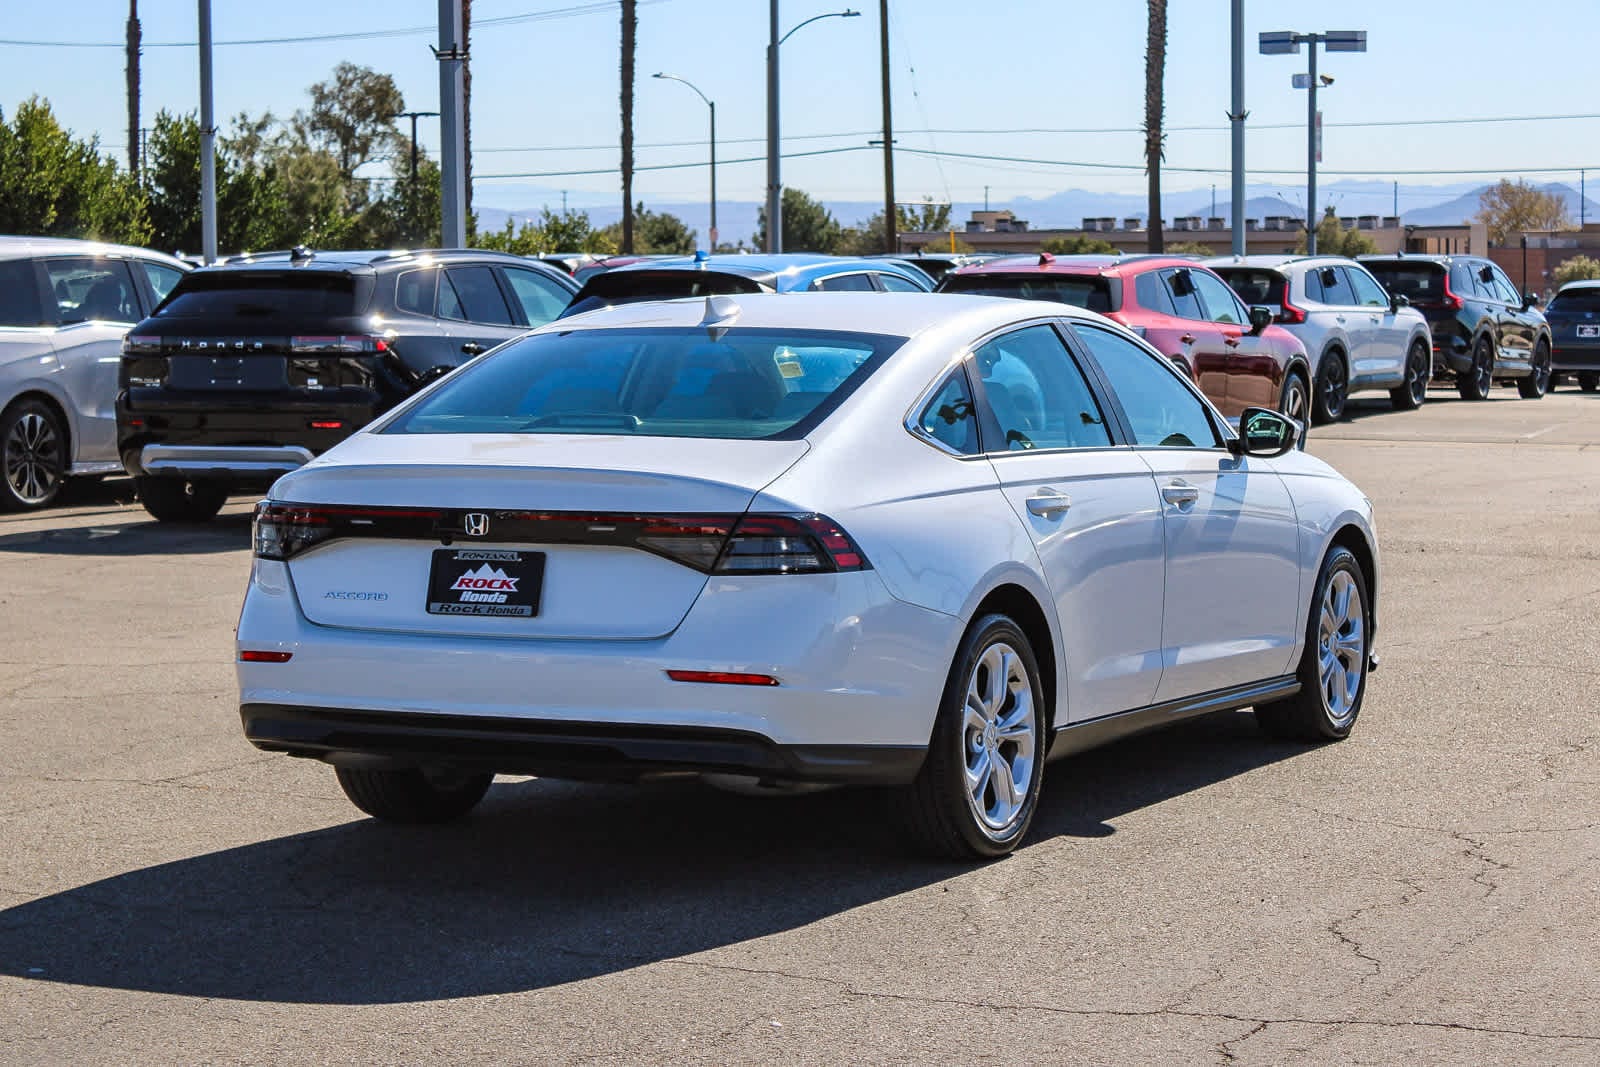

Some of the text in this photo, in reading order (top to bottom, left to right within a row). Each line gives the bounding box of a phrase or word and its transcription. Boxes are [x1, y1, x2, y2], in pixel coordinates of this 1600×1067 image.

[182, 340, 263, 349] Honda
[461, 552, 516, 560] FONTANA
[457, 577, 514, 590] ROCK
[324, 591, 389, 601] ACCORD
[459, 591, 508, 603] Honda
[485, 606, 526, 615] Honda
